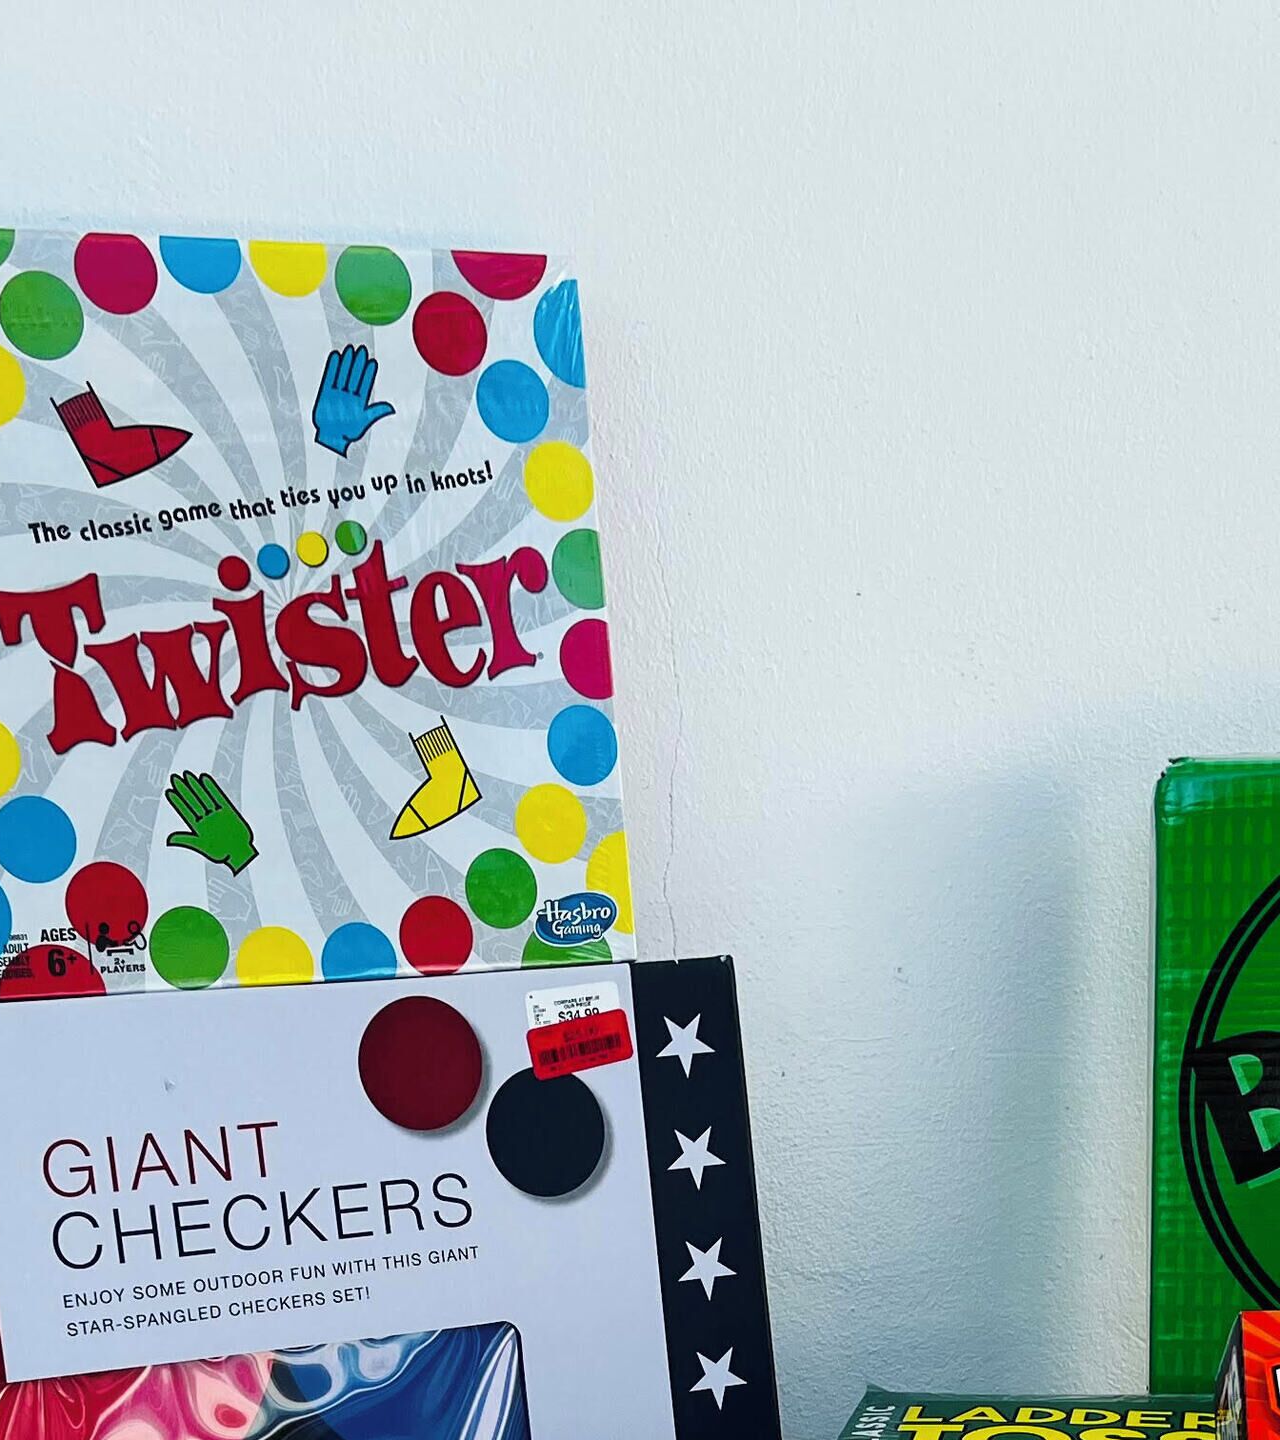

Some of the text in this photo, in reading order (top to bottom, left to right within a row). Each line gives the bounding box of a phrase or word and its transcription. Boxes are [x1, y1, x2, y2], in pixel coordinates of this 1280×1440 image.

[28, 461, 493, 544] The classic game that ties you up in knots!
[537, 900, 611, 924] Hasbro
[40, 928, 77, 942] AGES
[552, 921, 602, 939] Gaming
[3, 943, 29, 954] ADULT
[48, 949, 77, 977] 6+
[100, 964, 146, 973] PLAYERS
[558, 1007, 600, 1023] $3499
[42, 1121, 279, 1198] GIANT
[52, 1173, 473, 1270] CHECKERS
[63, 1245, 480, 1310] ENJOY SOME OUTDOOR FUN WITH THIS GIANT
[66, 1286, 371, 1337] STAR-SPANGLED CHECKERS SET!
